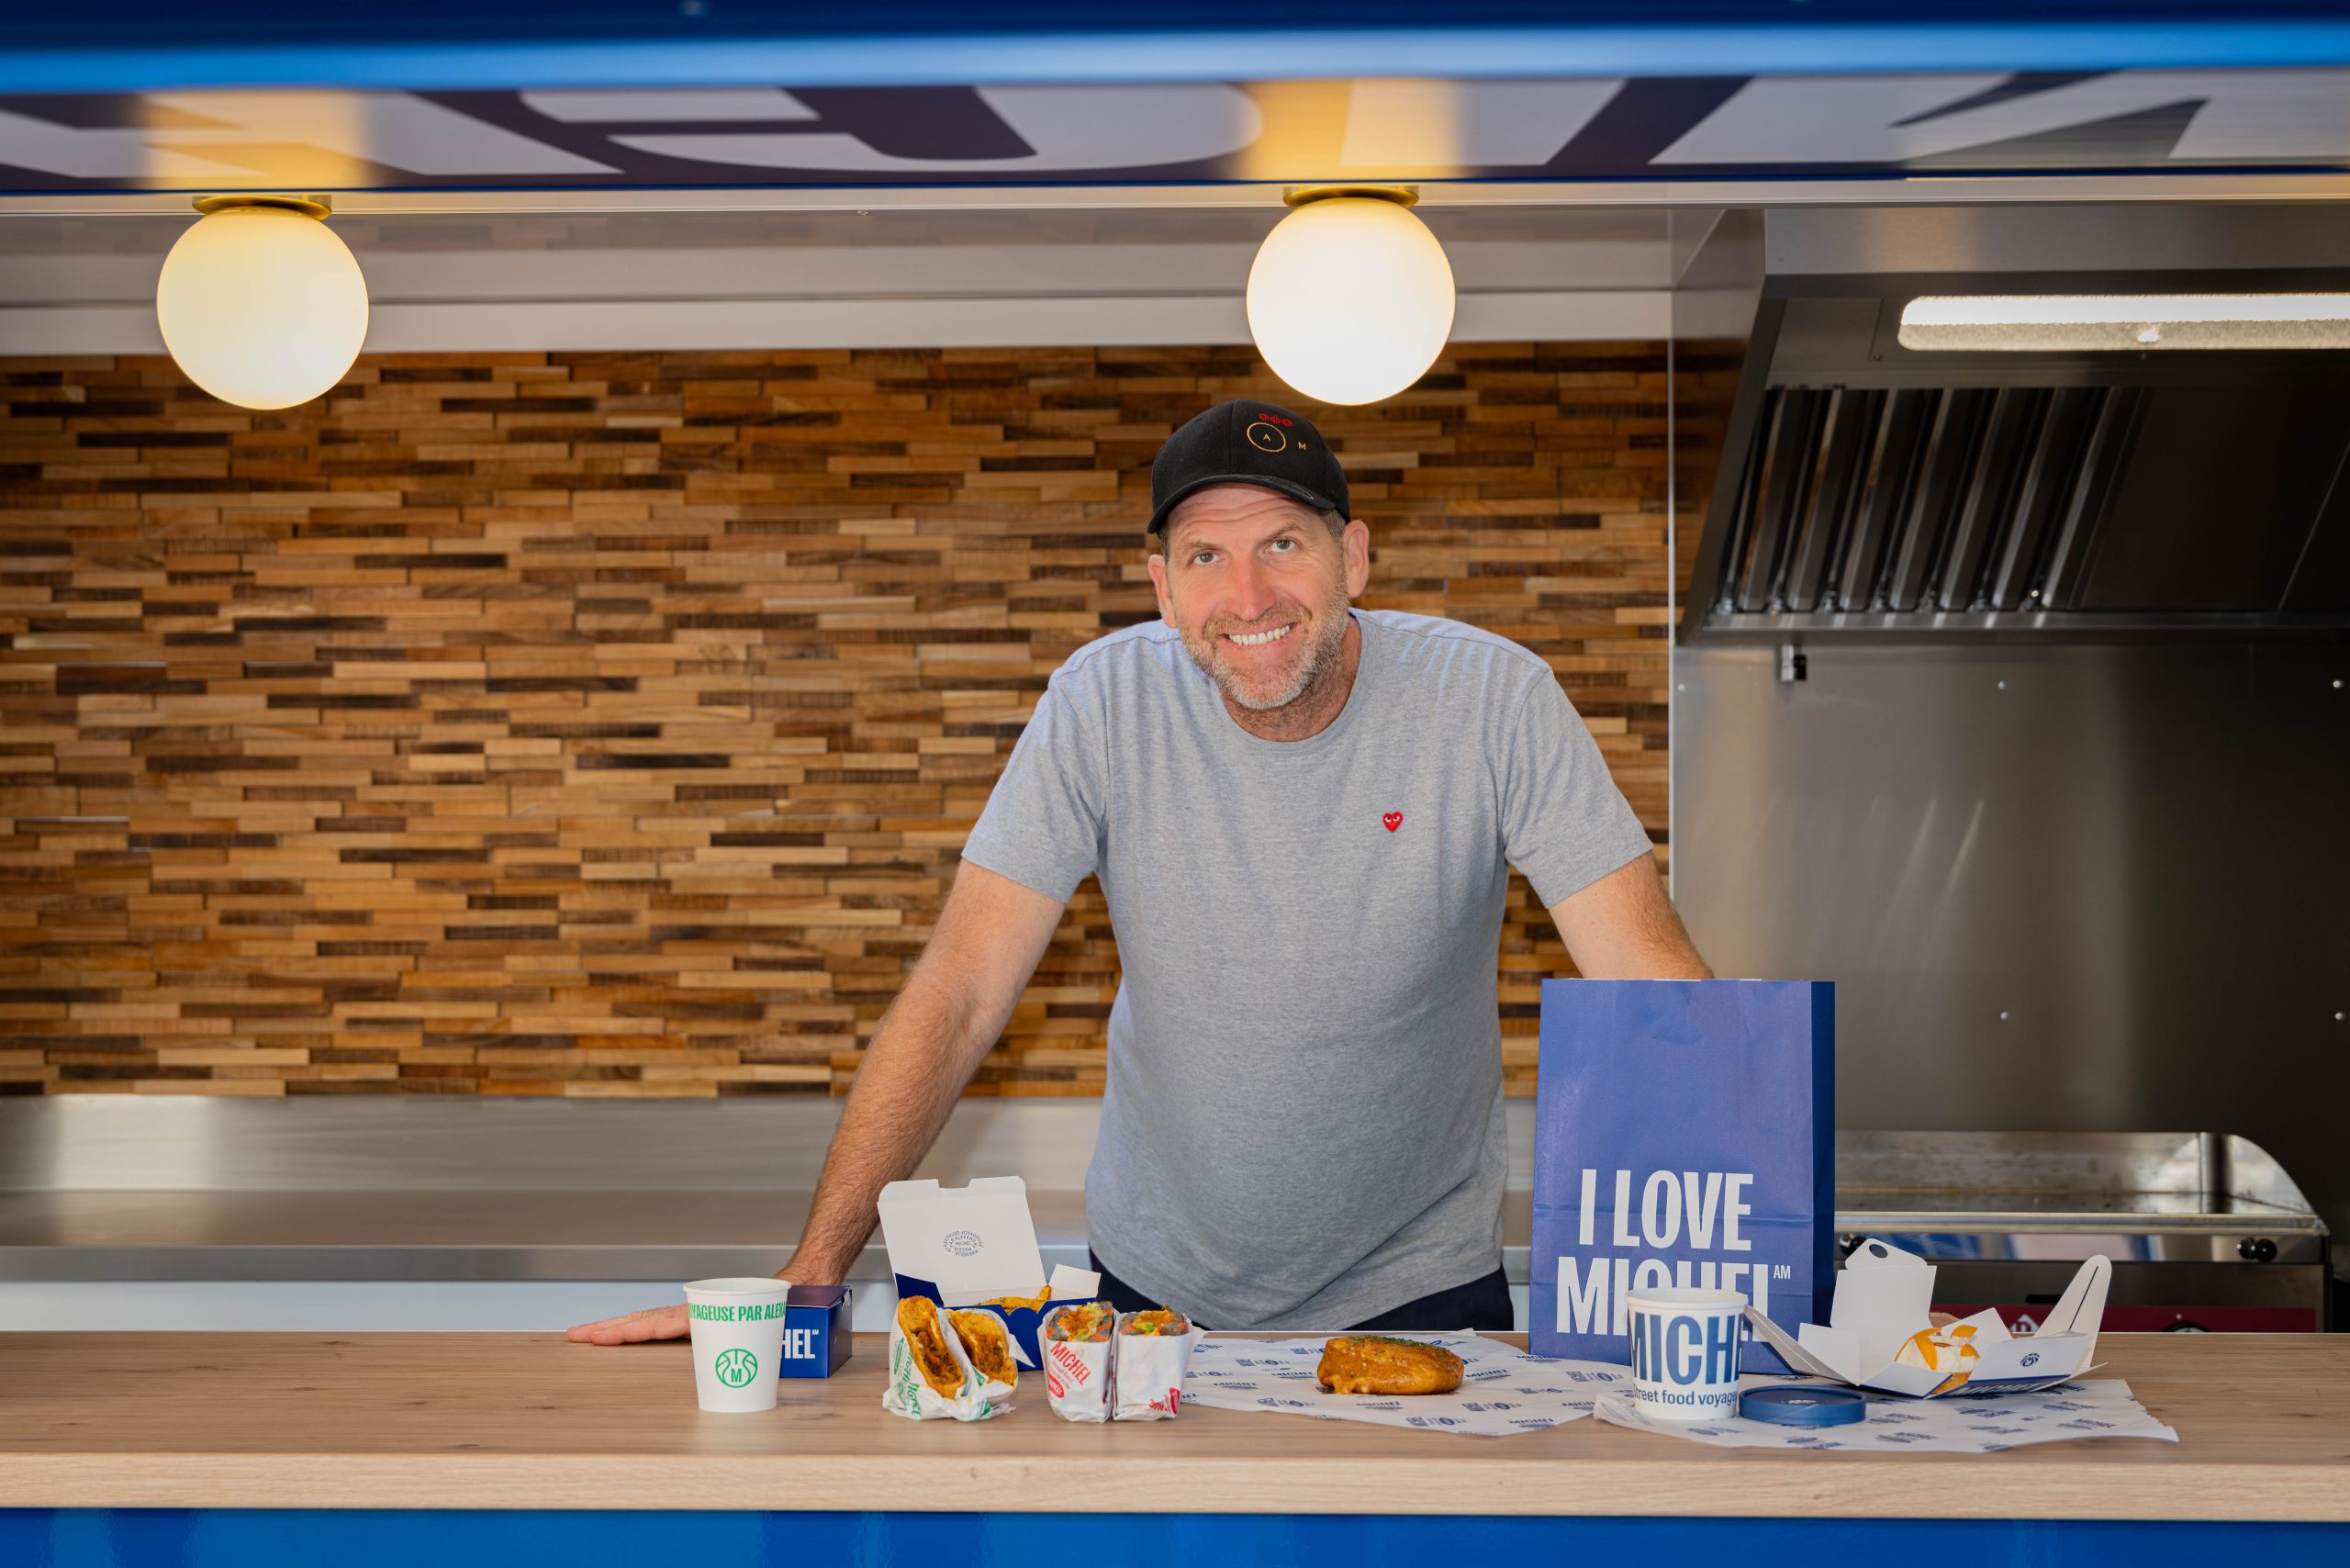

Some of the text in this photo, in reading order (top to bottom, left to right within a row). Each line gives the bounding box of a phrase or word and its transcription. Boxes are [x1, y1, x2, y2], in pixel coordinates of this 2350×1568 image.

[1297, 441, 1306, 450] M
[1579, 1169, 1754, 1251] I LOVE
[1773, 1265, 1791, 1280] AM
[738, 1305, 762, 1322] PAR
[1050, 1341, 1091, 1385] MICHEL
[731, 1368, 742, 1383] M
[1662, 1389, 1695, 1405] food
